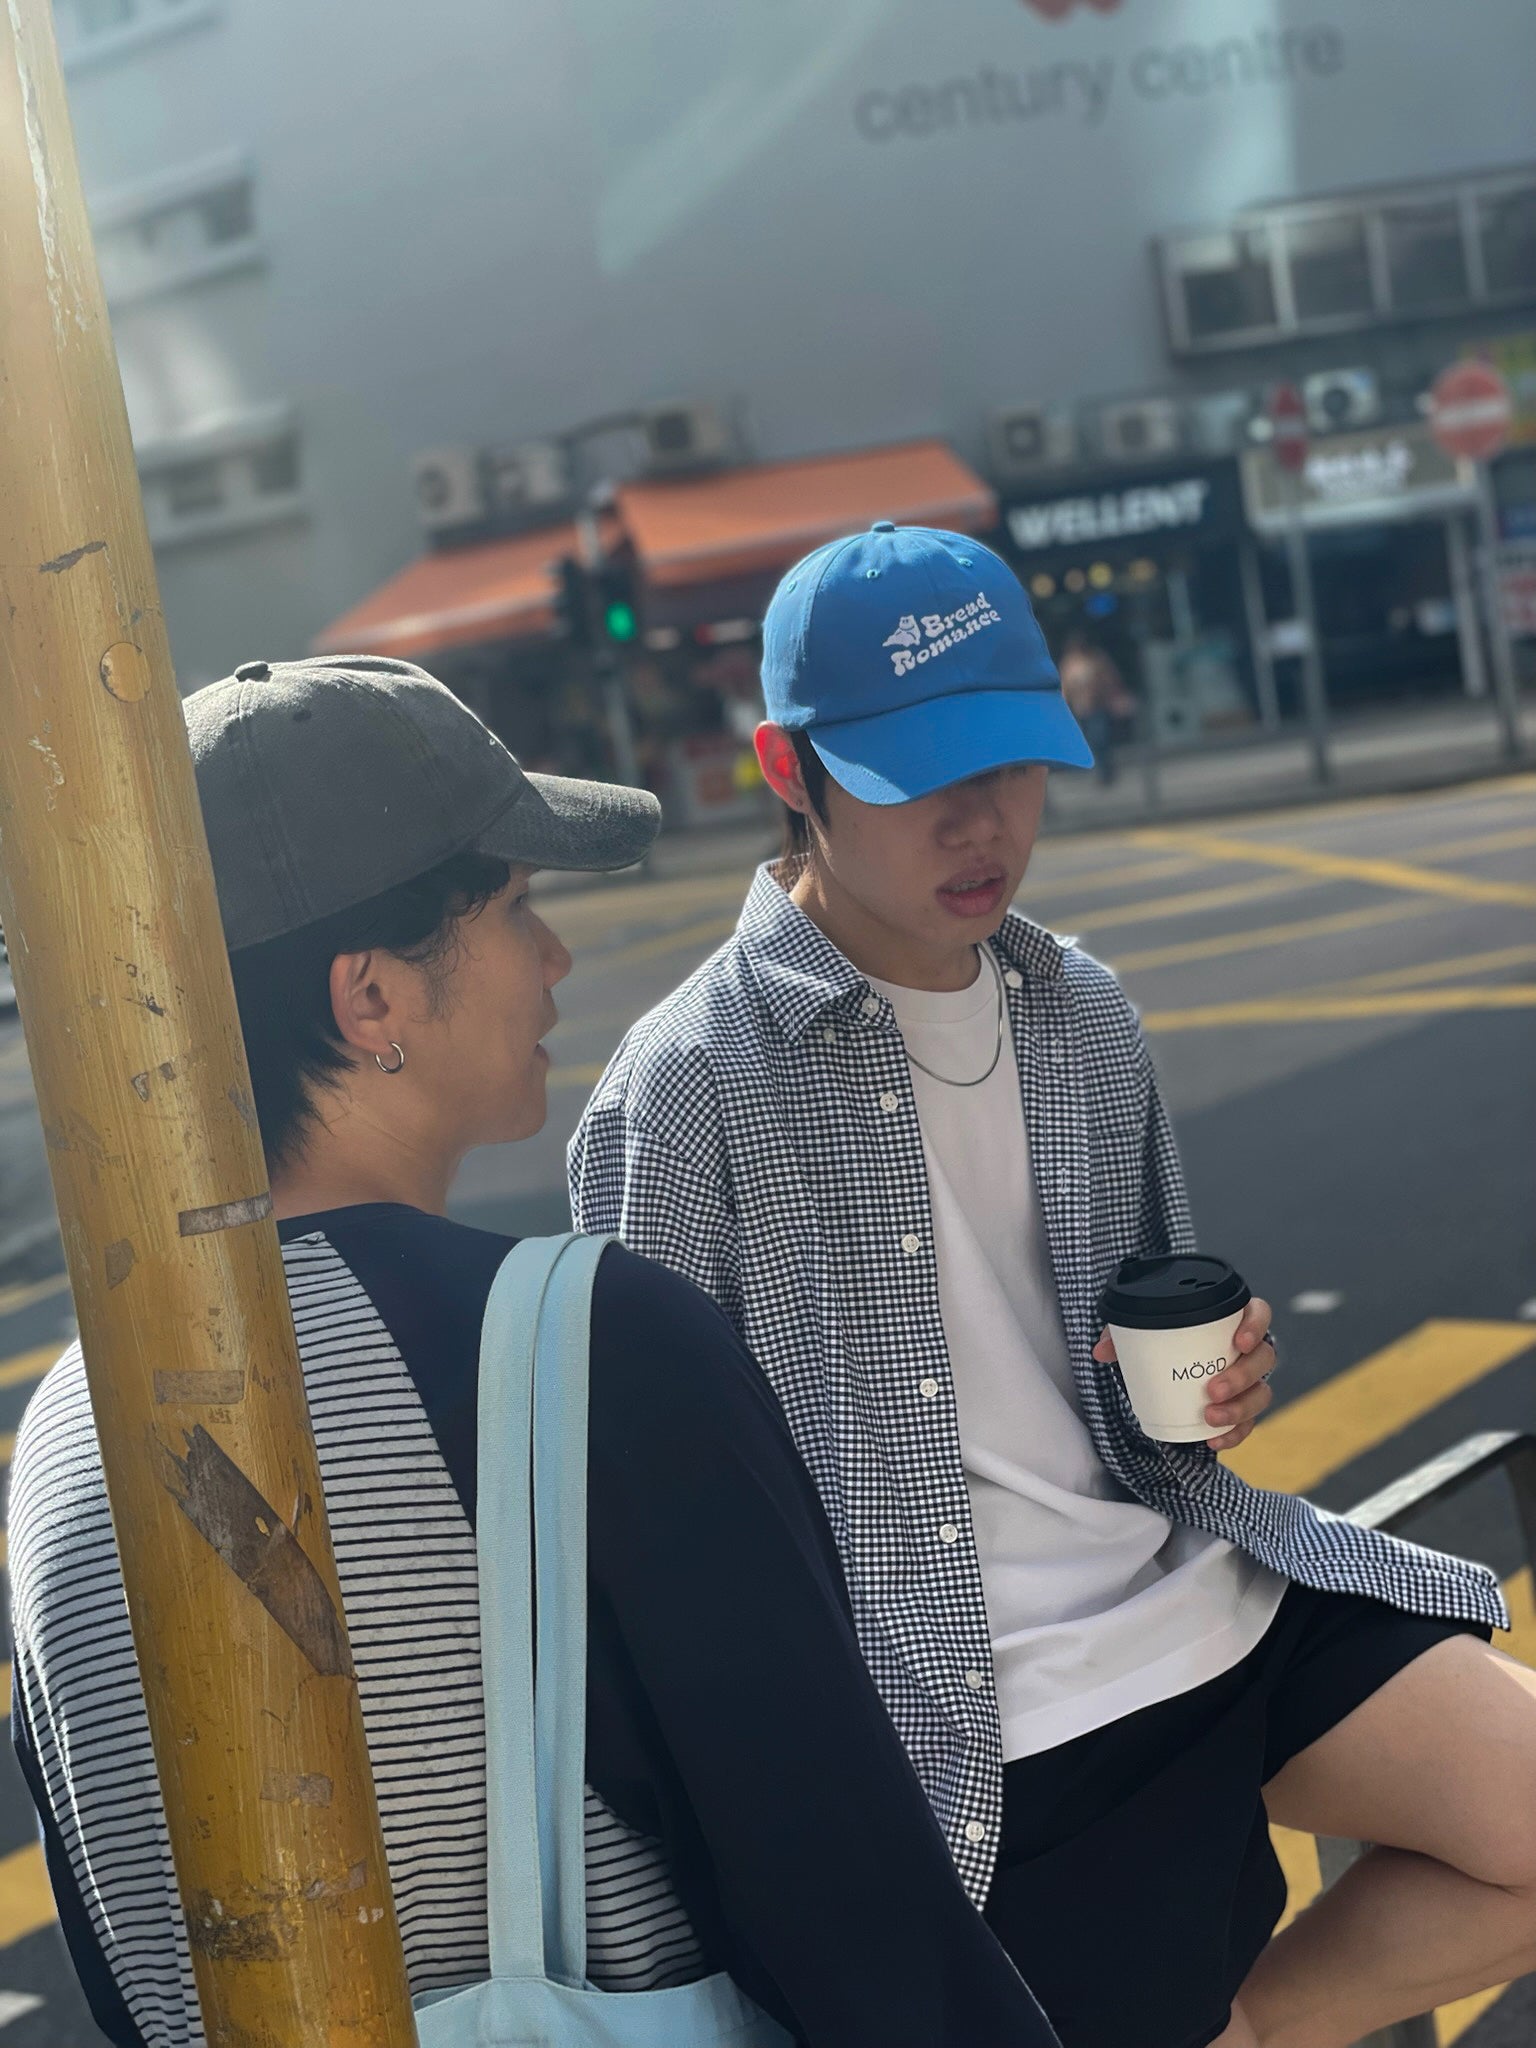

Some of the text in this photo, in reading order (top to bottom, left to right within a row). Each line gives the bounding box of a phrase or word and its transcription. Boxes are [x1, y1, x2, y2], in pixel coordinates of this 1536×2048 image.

[854, 22, 1344, 142] century centre
[890, 609, 1001, 677] Romance
[920, 591, 992, 638] Bread
